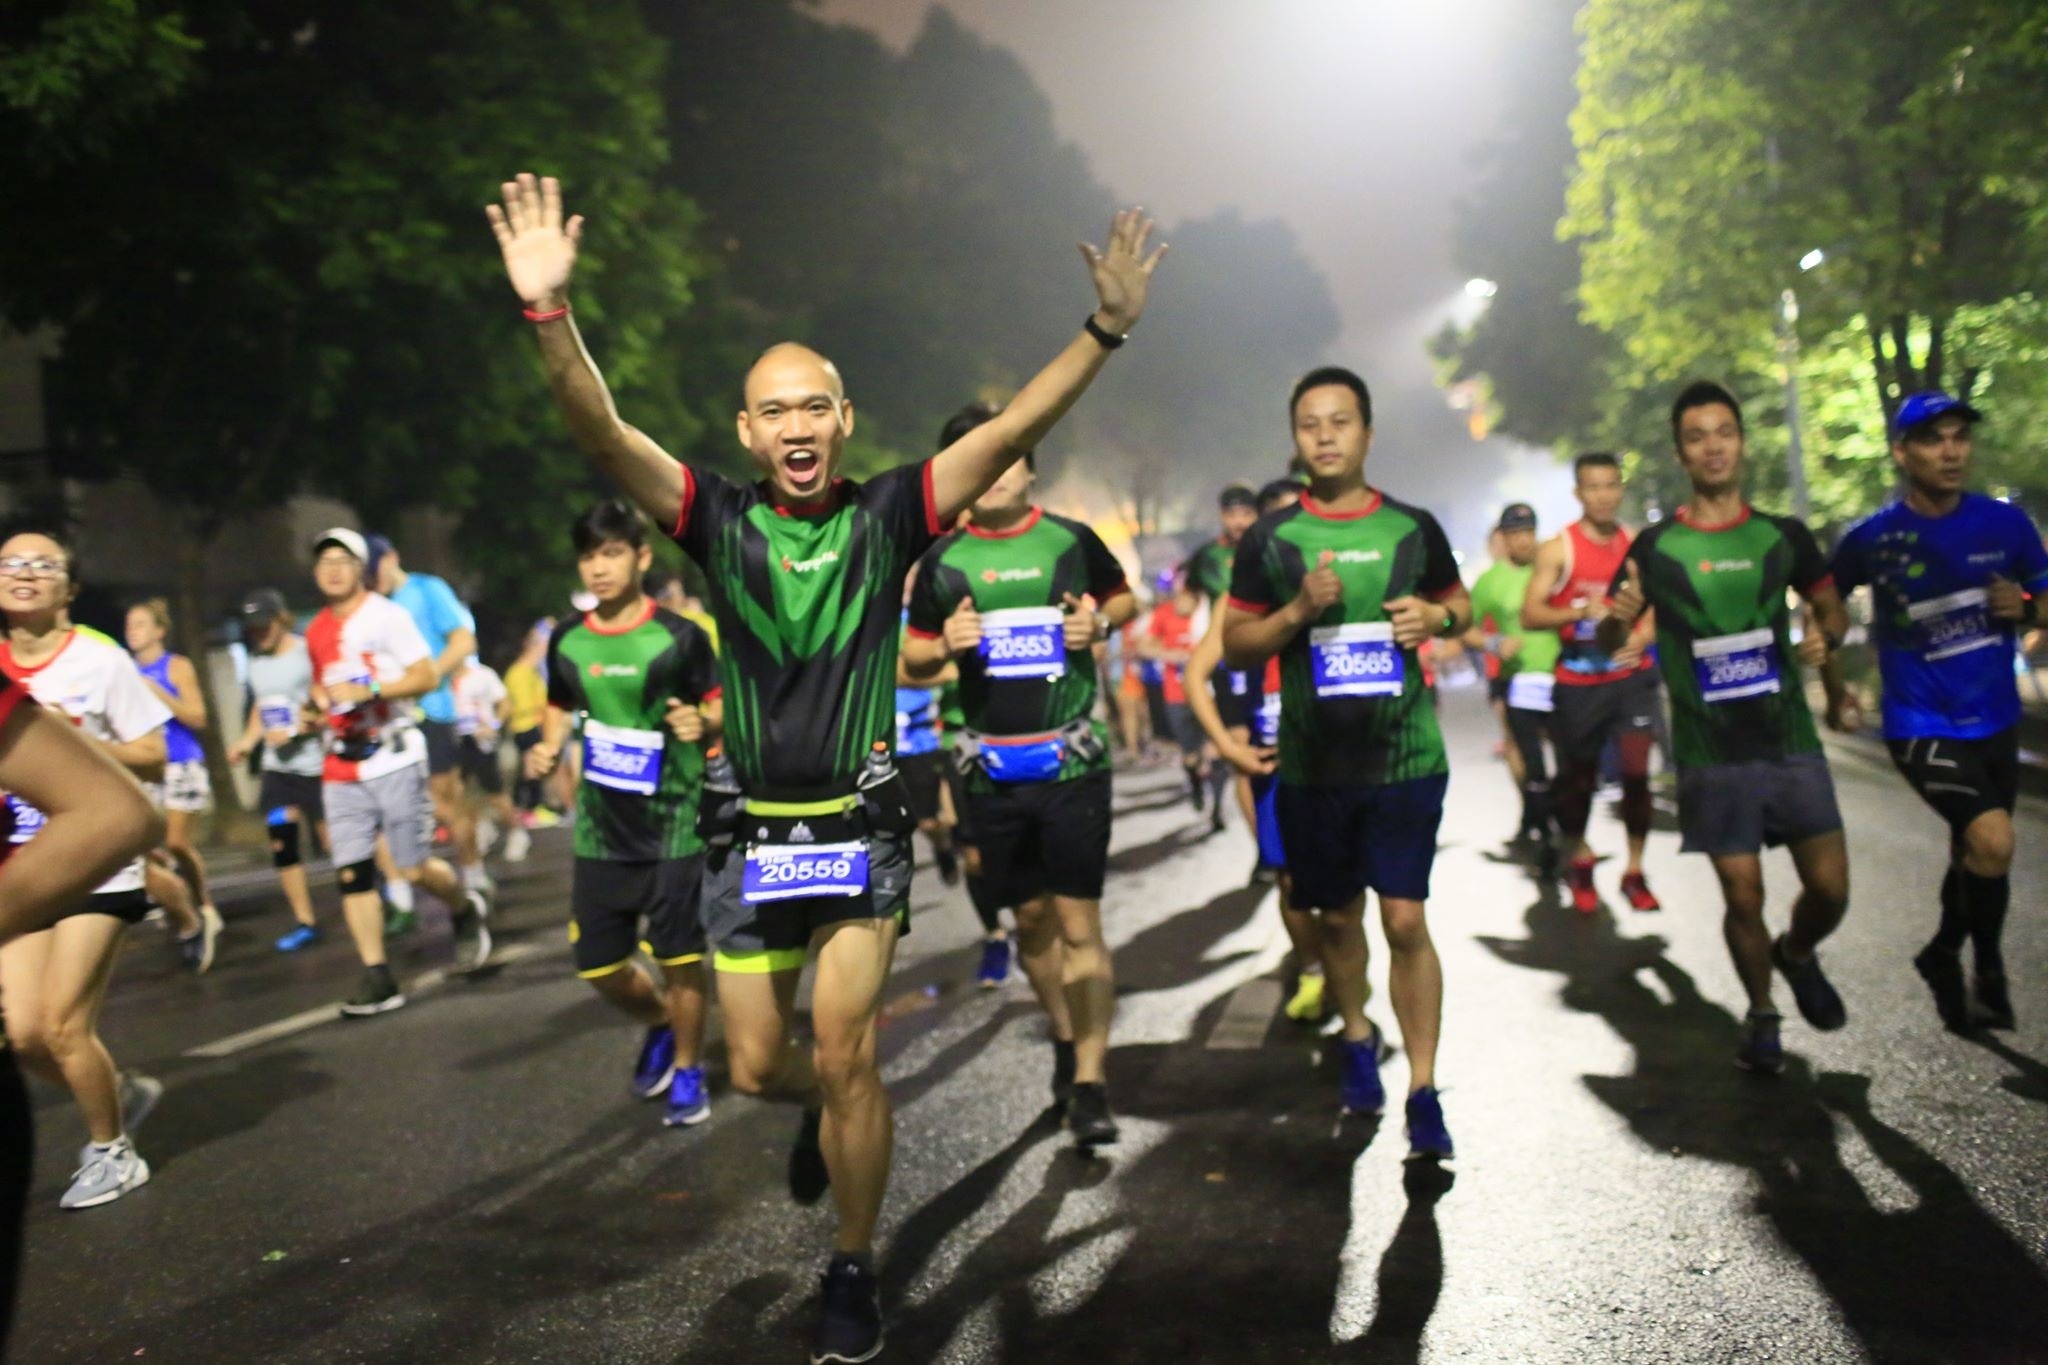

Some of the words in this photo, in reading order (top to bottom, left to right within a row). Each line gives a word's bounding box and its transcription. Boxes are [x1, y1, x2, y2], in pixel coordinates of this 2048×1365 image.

[988, 633, 1055, 659] 20553
[1324, 651, 1394, 677] 20565
[758, 860, 852, 884] 20559
